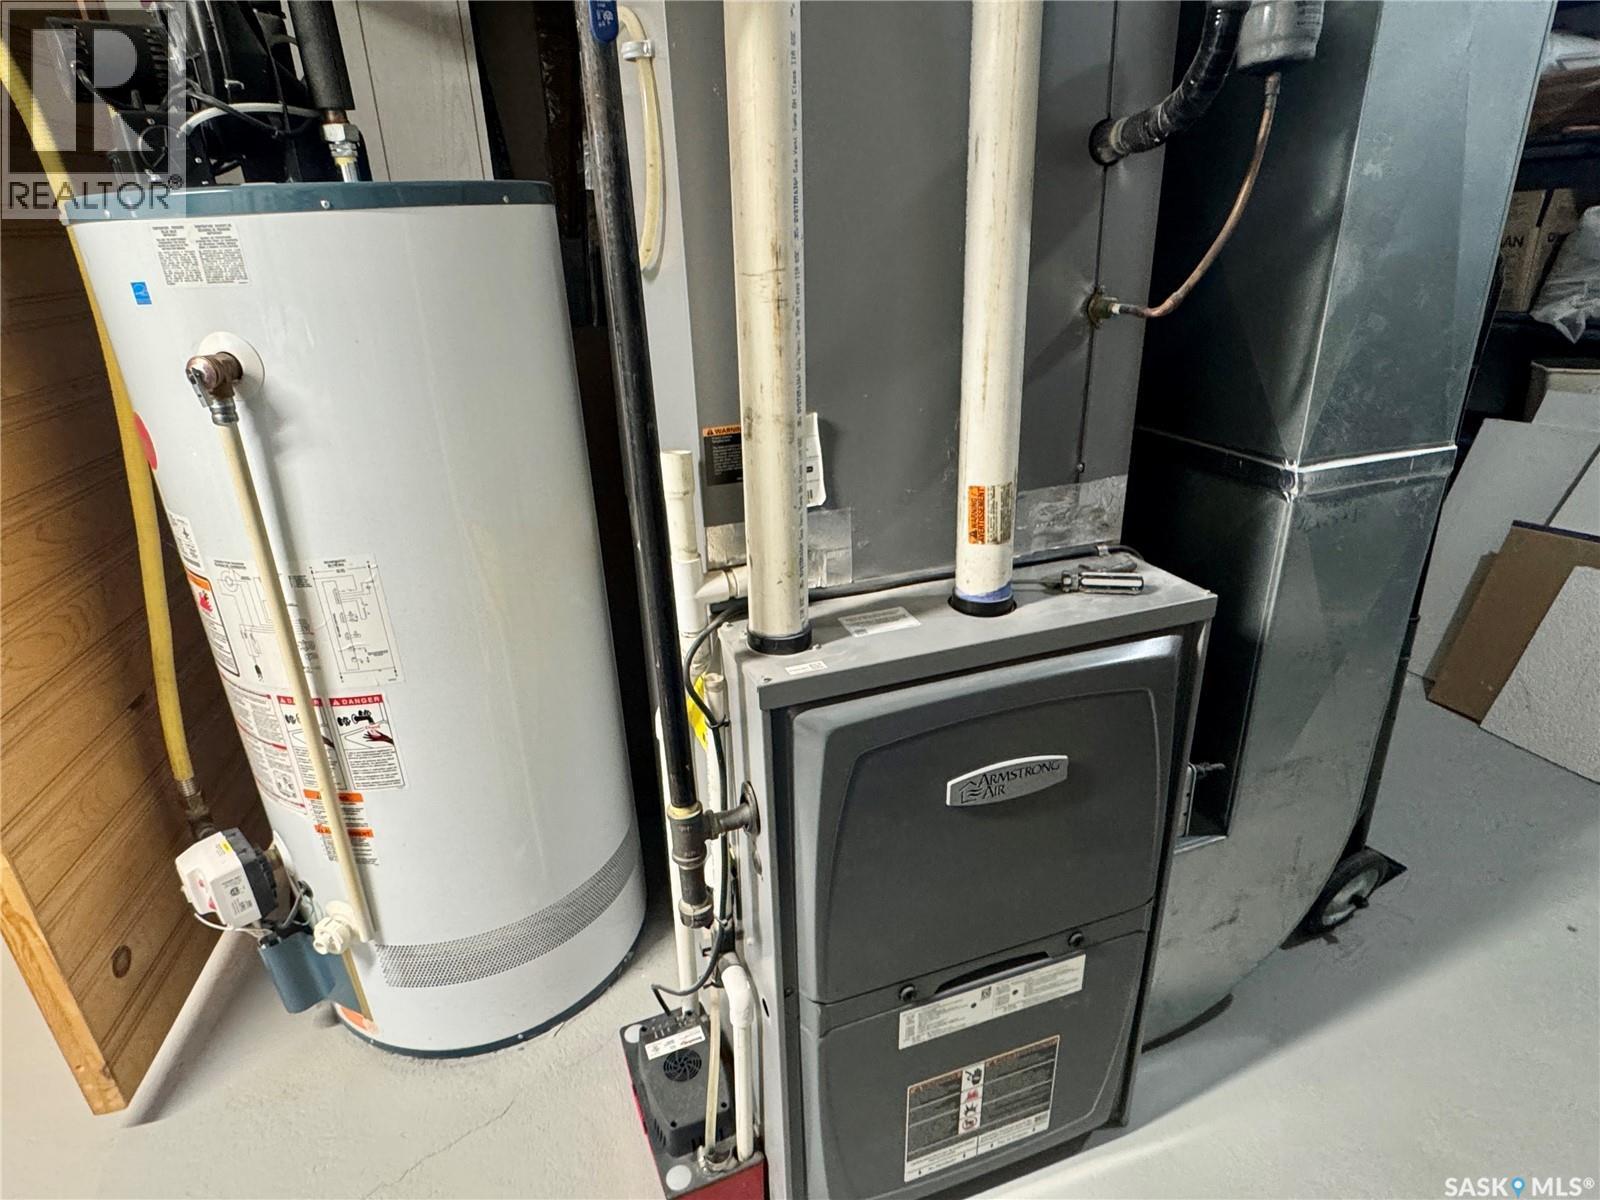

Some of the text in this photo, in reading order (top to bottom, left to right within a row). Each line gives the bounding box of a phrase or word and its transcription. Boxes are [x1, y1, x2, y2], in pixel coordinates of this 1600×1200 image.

[714, 426, 741, 434] WARNIN
[342, 697, 380, 705] DANGER
[977, 760, 1060, 788] ARMSTRONG
[982, 784, 1006, 800] AIR
